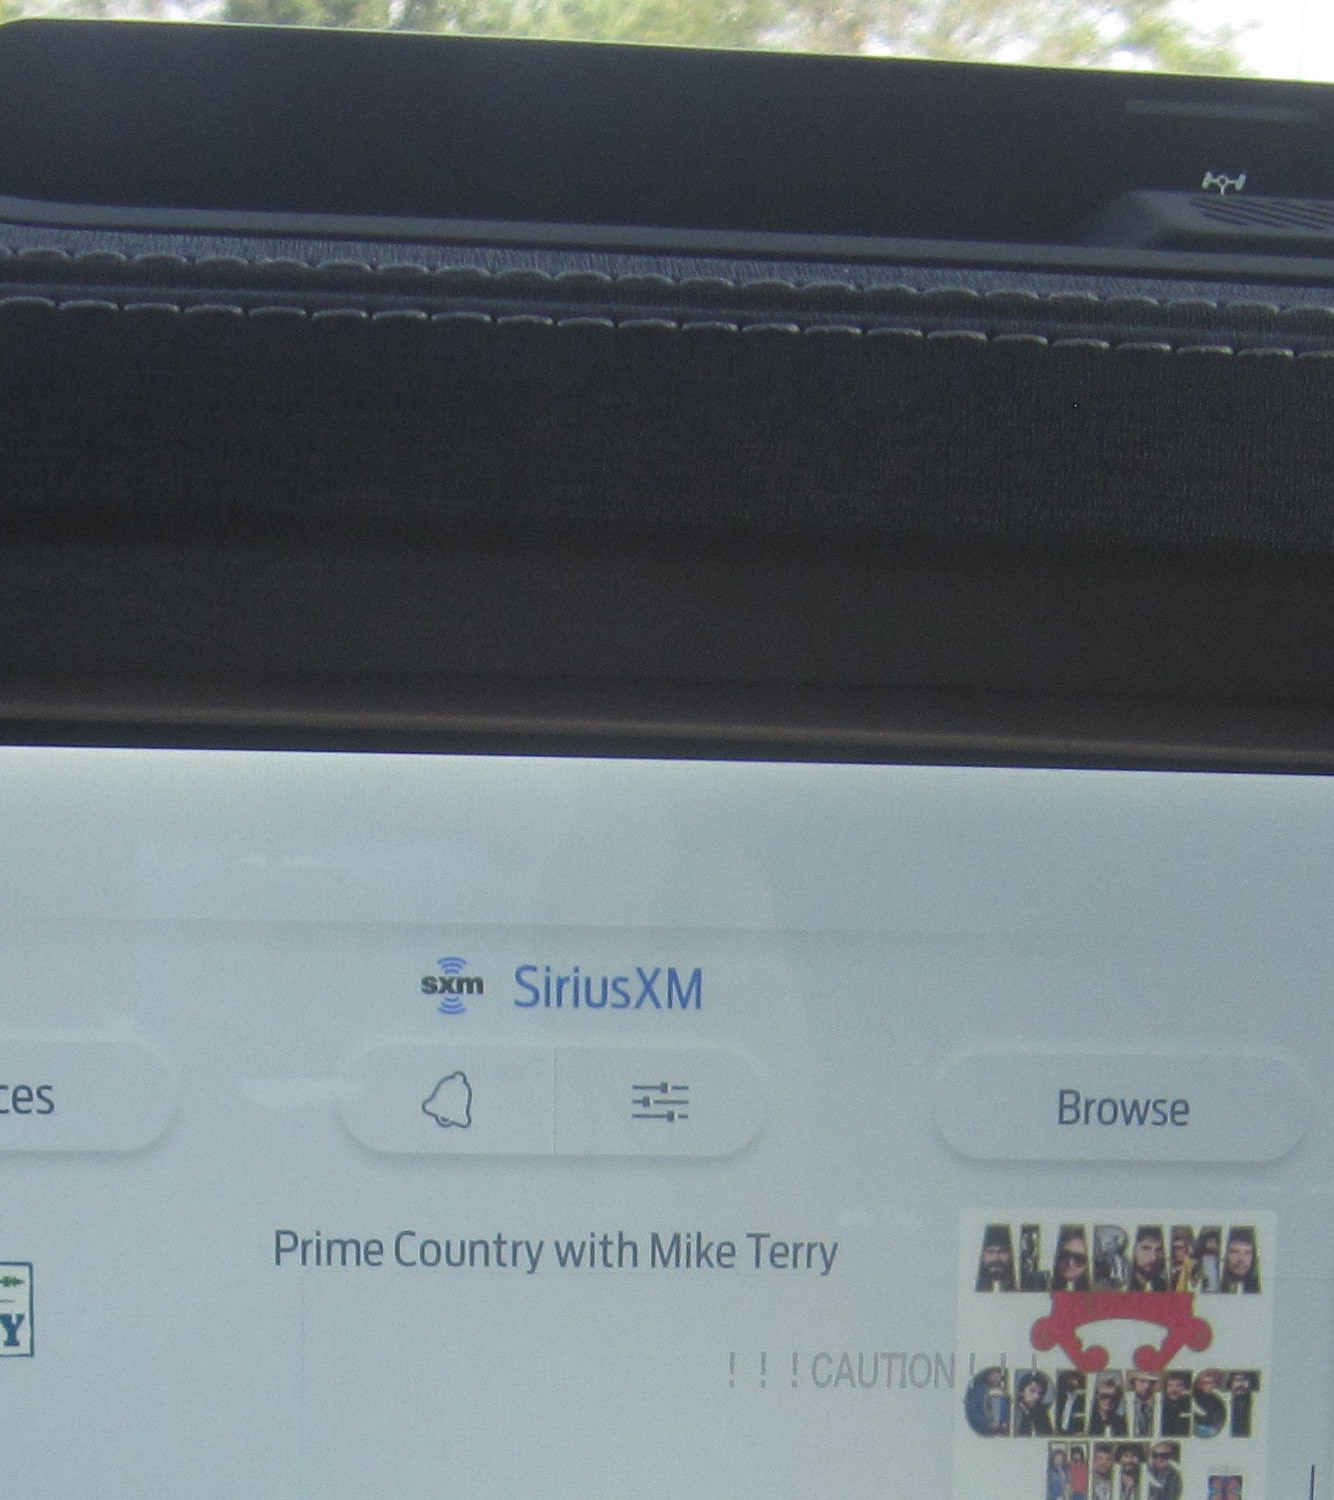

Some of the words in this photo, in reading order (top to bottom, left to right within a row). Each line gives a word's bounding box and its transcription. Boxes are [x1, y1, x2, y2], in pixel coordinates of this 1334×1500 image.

[420, 971, 484, 996] sxm
[513, 965, 704, 1011] SiriusXM
[1057, 1088, 1191, 1128] Browse
[273, 1229, 384, 1269] Prime
[394, 1230, 544, 1276] Country
[554, 1229, 640, 1270] with
[649, 1230, 738, 1270] Mike
[746, 1231, 839, 1276] Terry
[973, 1222, 1262, 1295] ALABAMA
[963, 1365, 1262, 1439] GREATEST
